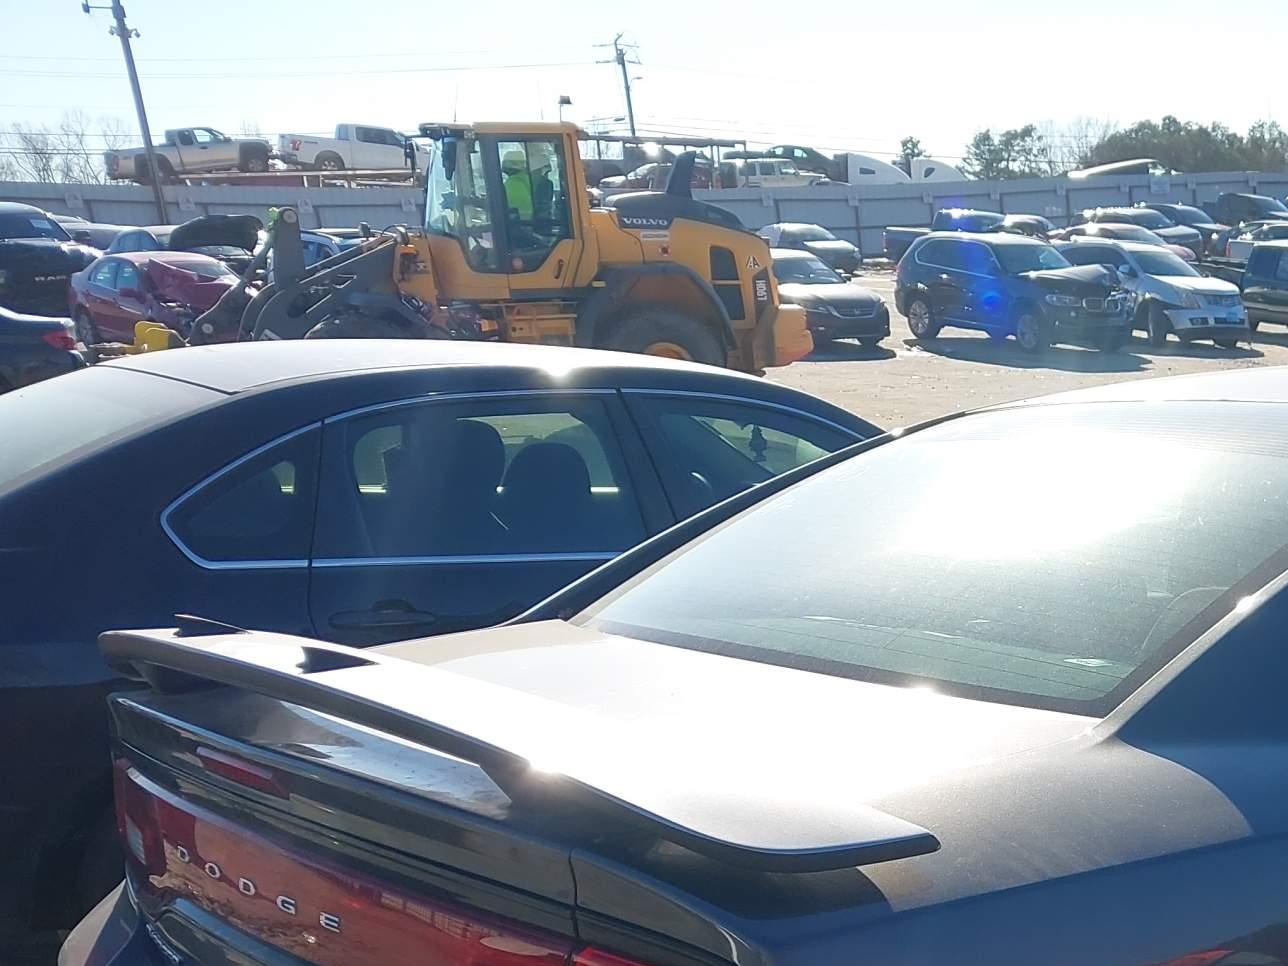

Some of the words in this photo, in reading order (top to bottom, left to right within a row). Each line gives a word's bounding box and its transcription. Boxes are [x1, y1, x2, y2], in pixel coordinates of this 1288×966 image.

[622, 217, 668, 227] VOLVO
[756, 279, 768, 301] L90H
[176, 844, 342, 933] DODGE
